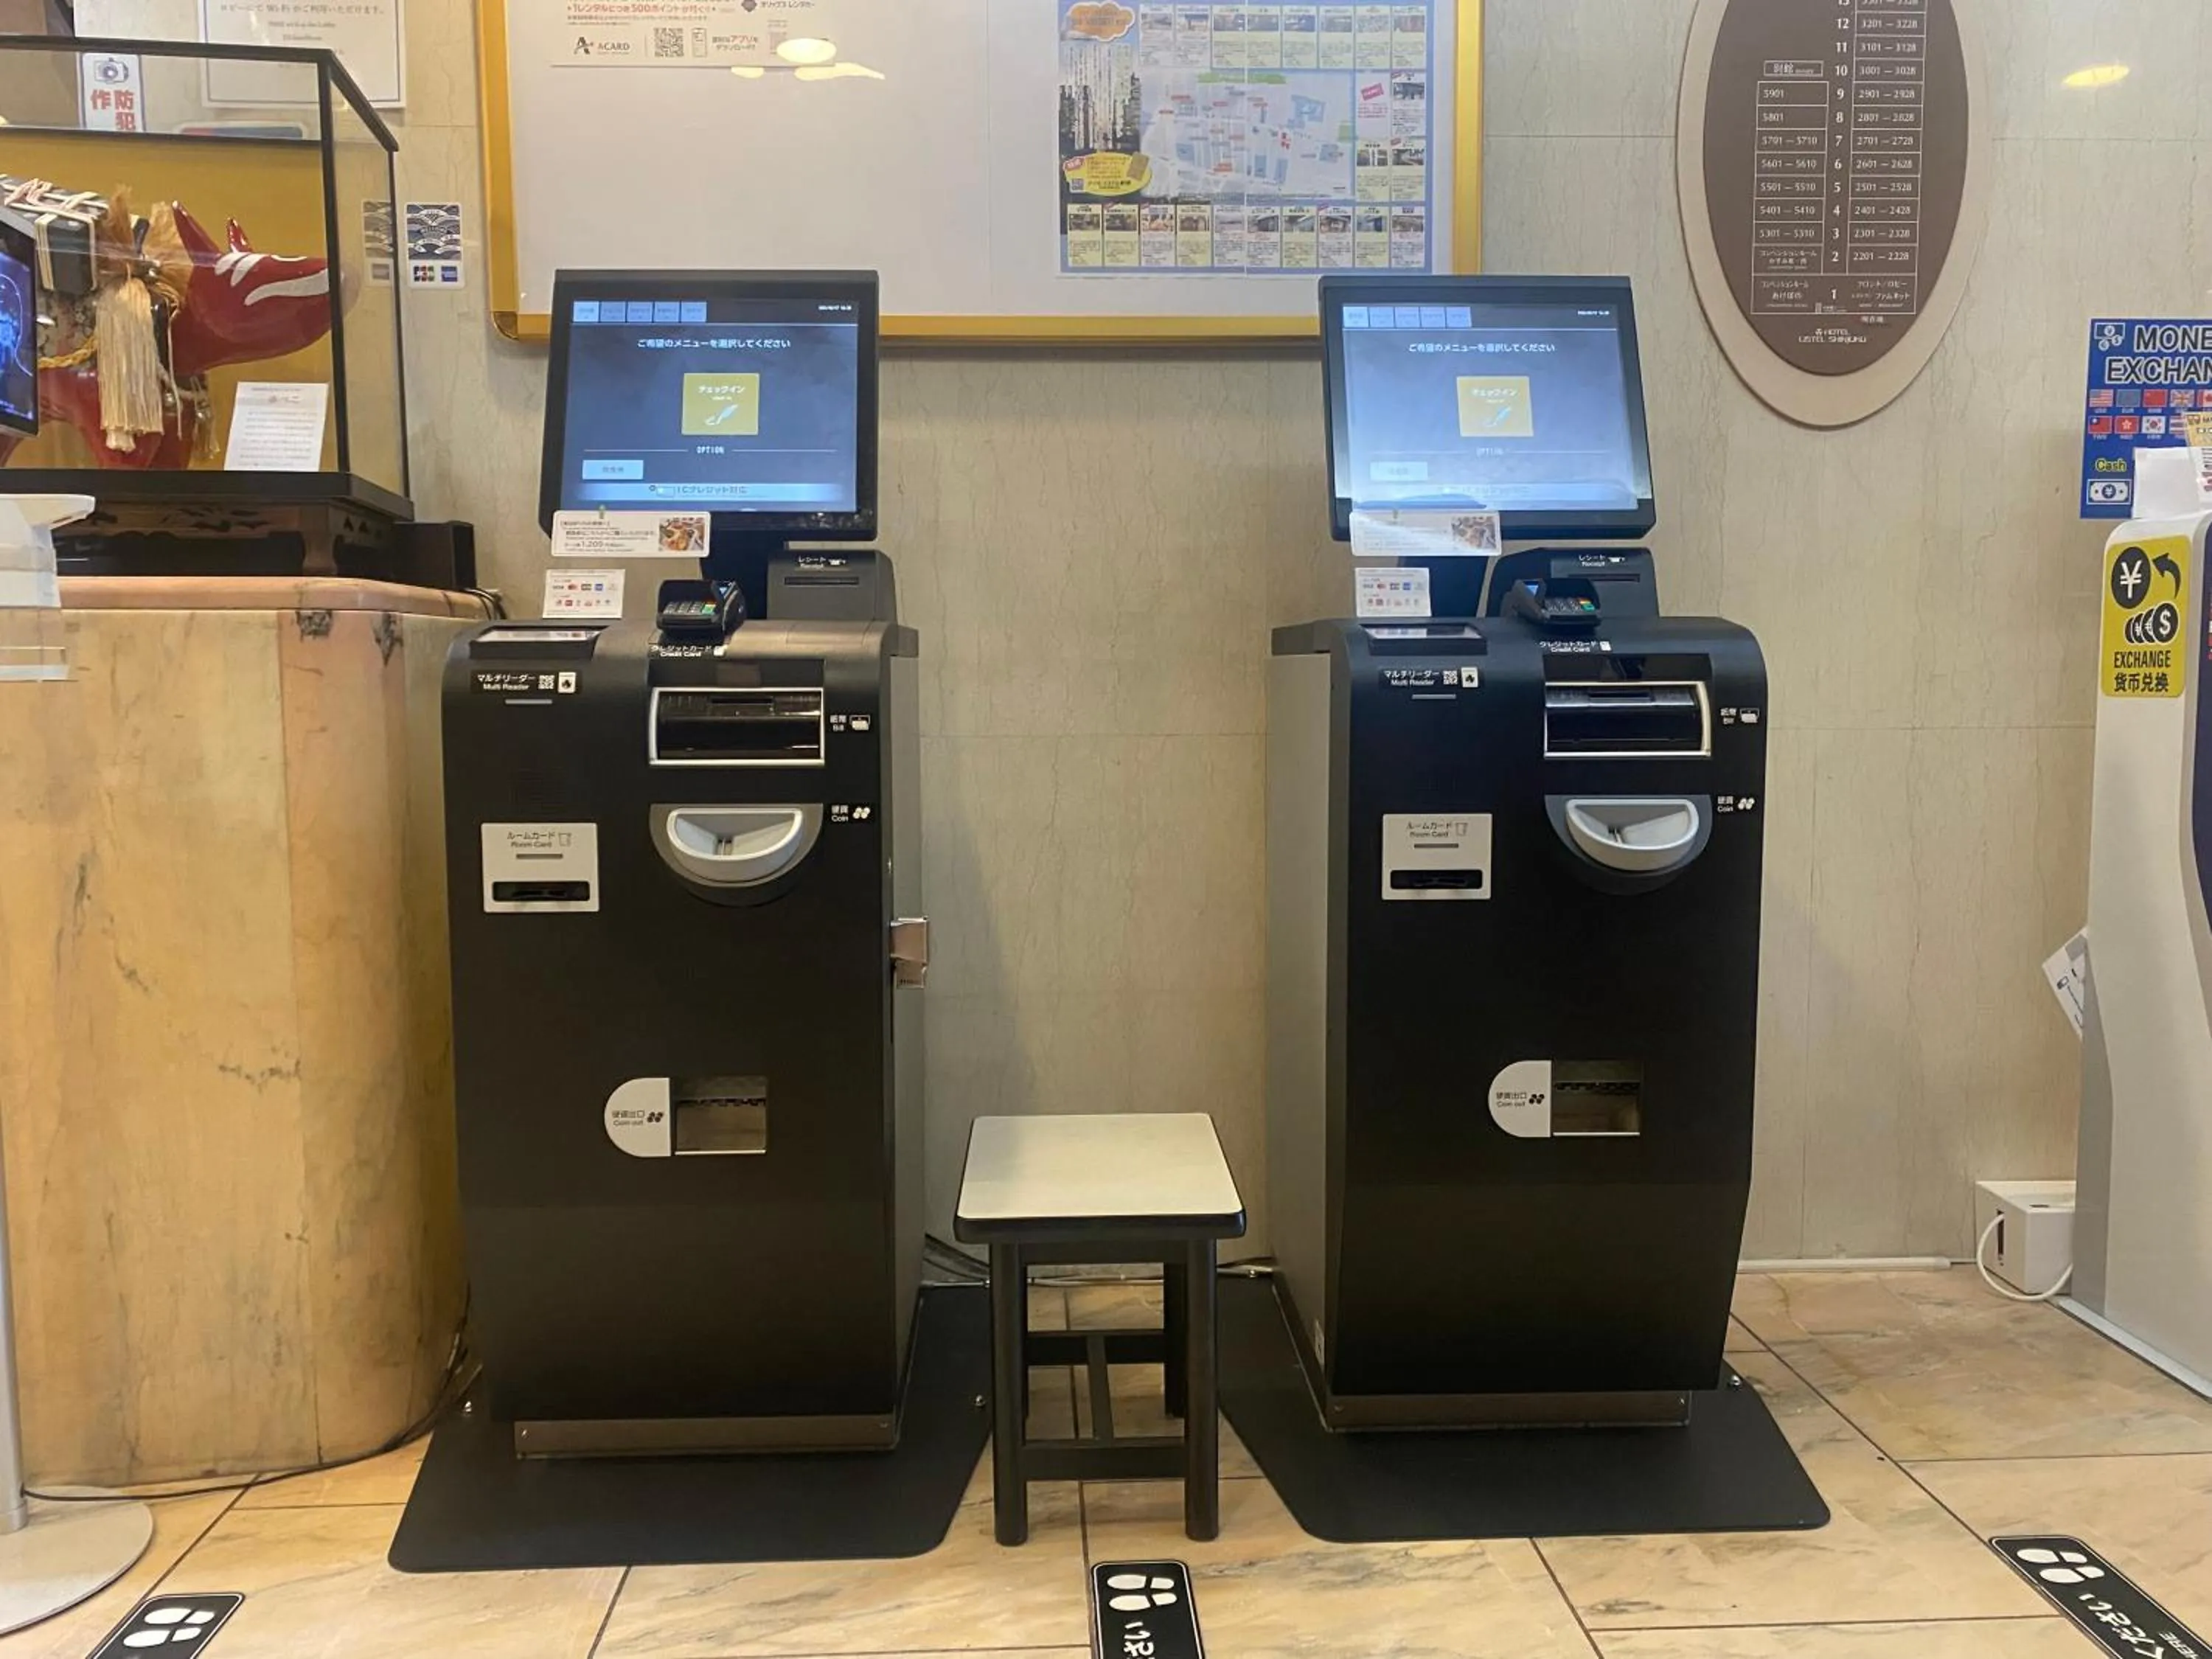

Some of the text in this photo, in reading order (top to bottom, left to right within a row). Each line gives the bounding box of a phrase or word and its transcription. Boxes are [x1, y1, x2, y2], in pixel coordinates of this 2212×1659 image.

[1836, 18, 1849, 29] 12
[1836, 42, 1847, 53] 11
[1834, 64, 1848, 76] 10
[1837, 88, 1844, 100] 9
[1836, 111, 1844, 123] 8
[1835, 135, 1843, 147] 7
[1834, 159, 1843, 170] 6
[1834, 182, 1841, 192] 5
[1833, 205, 1840, 217] 4
[1832, 228, 1840, 240] 3
[1832, 251, 1839, 262] 2
[1832, 288, 1837, 299] 1
[2095, 458, 2127, 473] Cash
[2113, 650, 2171, 669] EXCHANGE
[477, 674, 536, 682] マルチリーダー
[1384, 669, 1440, 678] マルチリーダー
[2114, 672, 2169, 693] 货币兑换
[1717, 805, 1733, 813] Coin
[831, 814, 848, 822] Coin
[1406, 821, 1453, 830] ルームカード
[507, 831, 556, 840] ルームカード
[1124, 1621, 1155, 1659] さい
